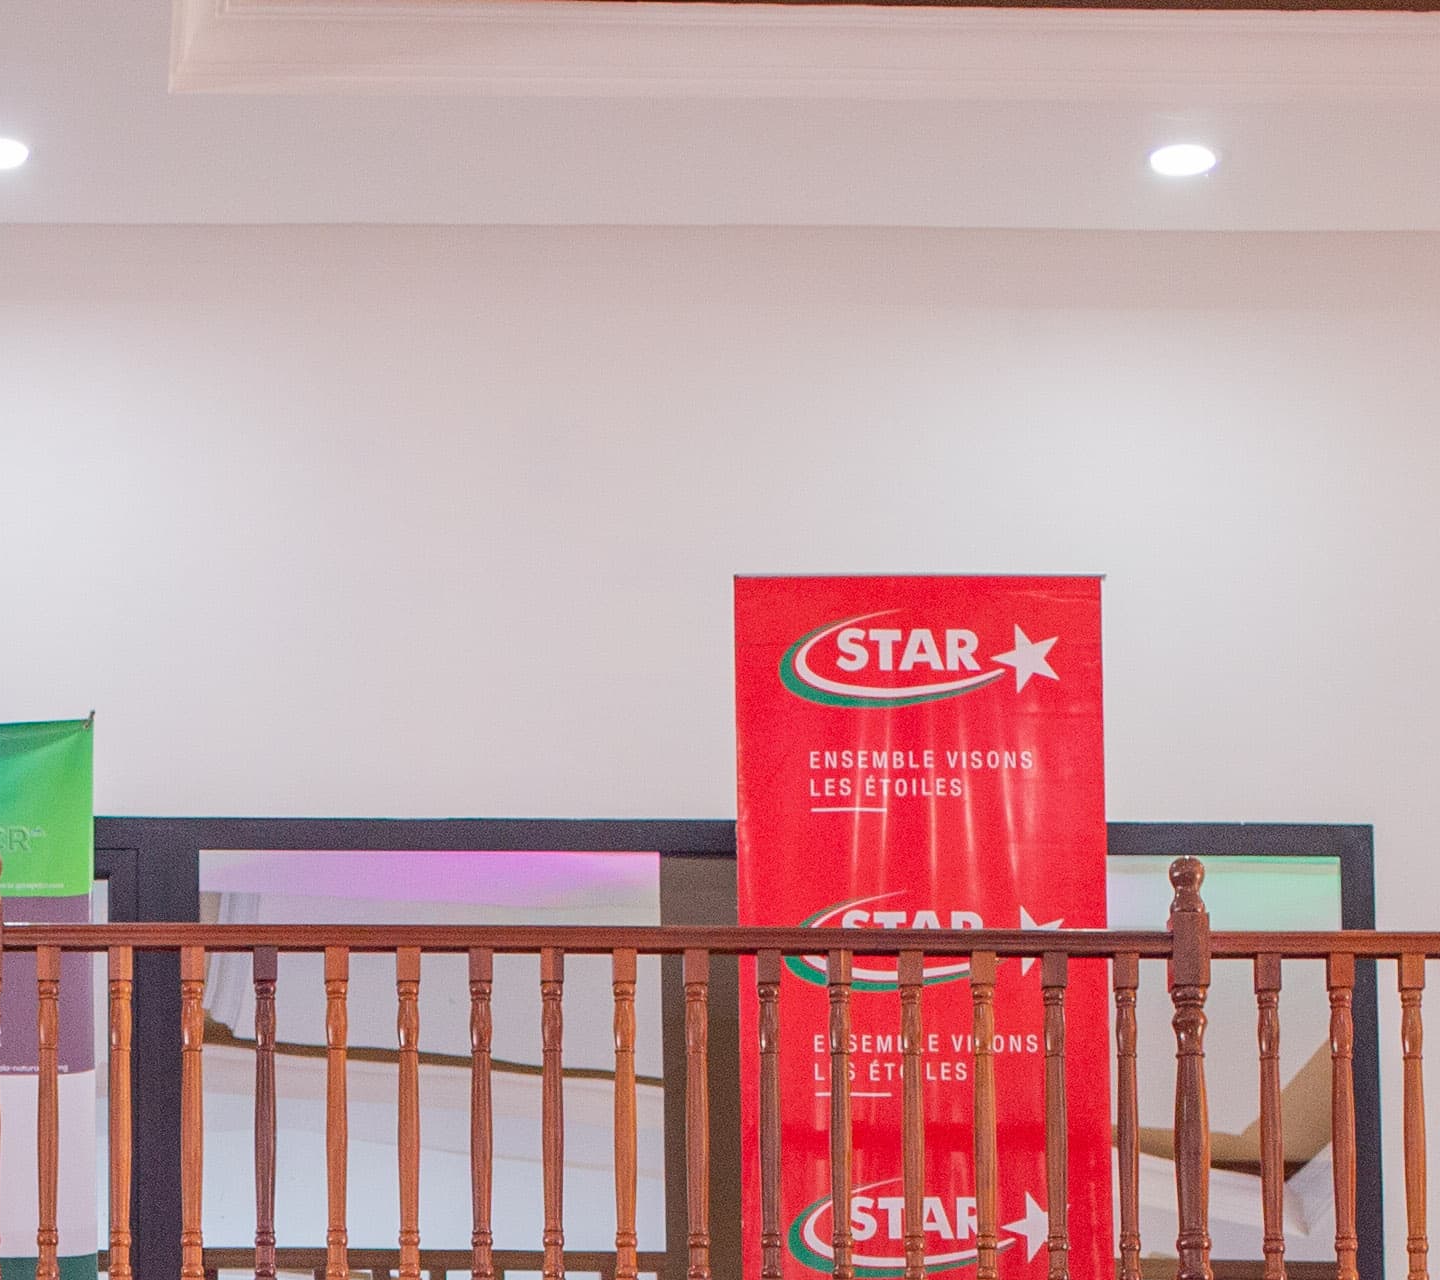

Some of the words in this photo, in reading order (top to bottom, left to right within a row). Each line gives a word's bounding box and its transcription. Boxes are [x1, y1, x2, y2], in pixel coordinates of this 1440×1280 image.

[835, 628, 981, 672] STAR
[809, 750, 935, 769] ENSEMBLE
[946, 750, 1034, 769] VISONS
[810, 778, 852, 797] LES
[865, 774, 963, 797] ÉTOILES
